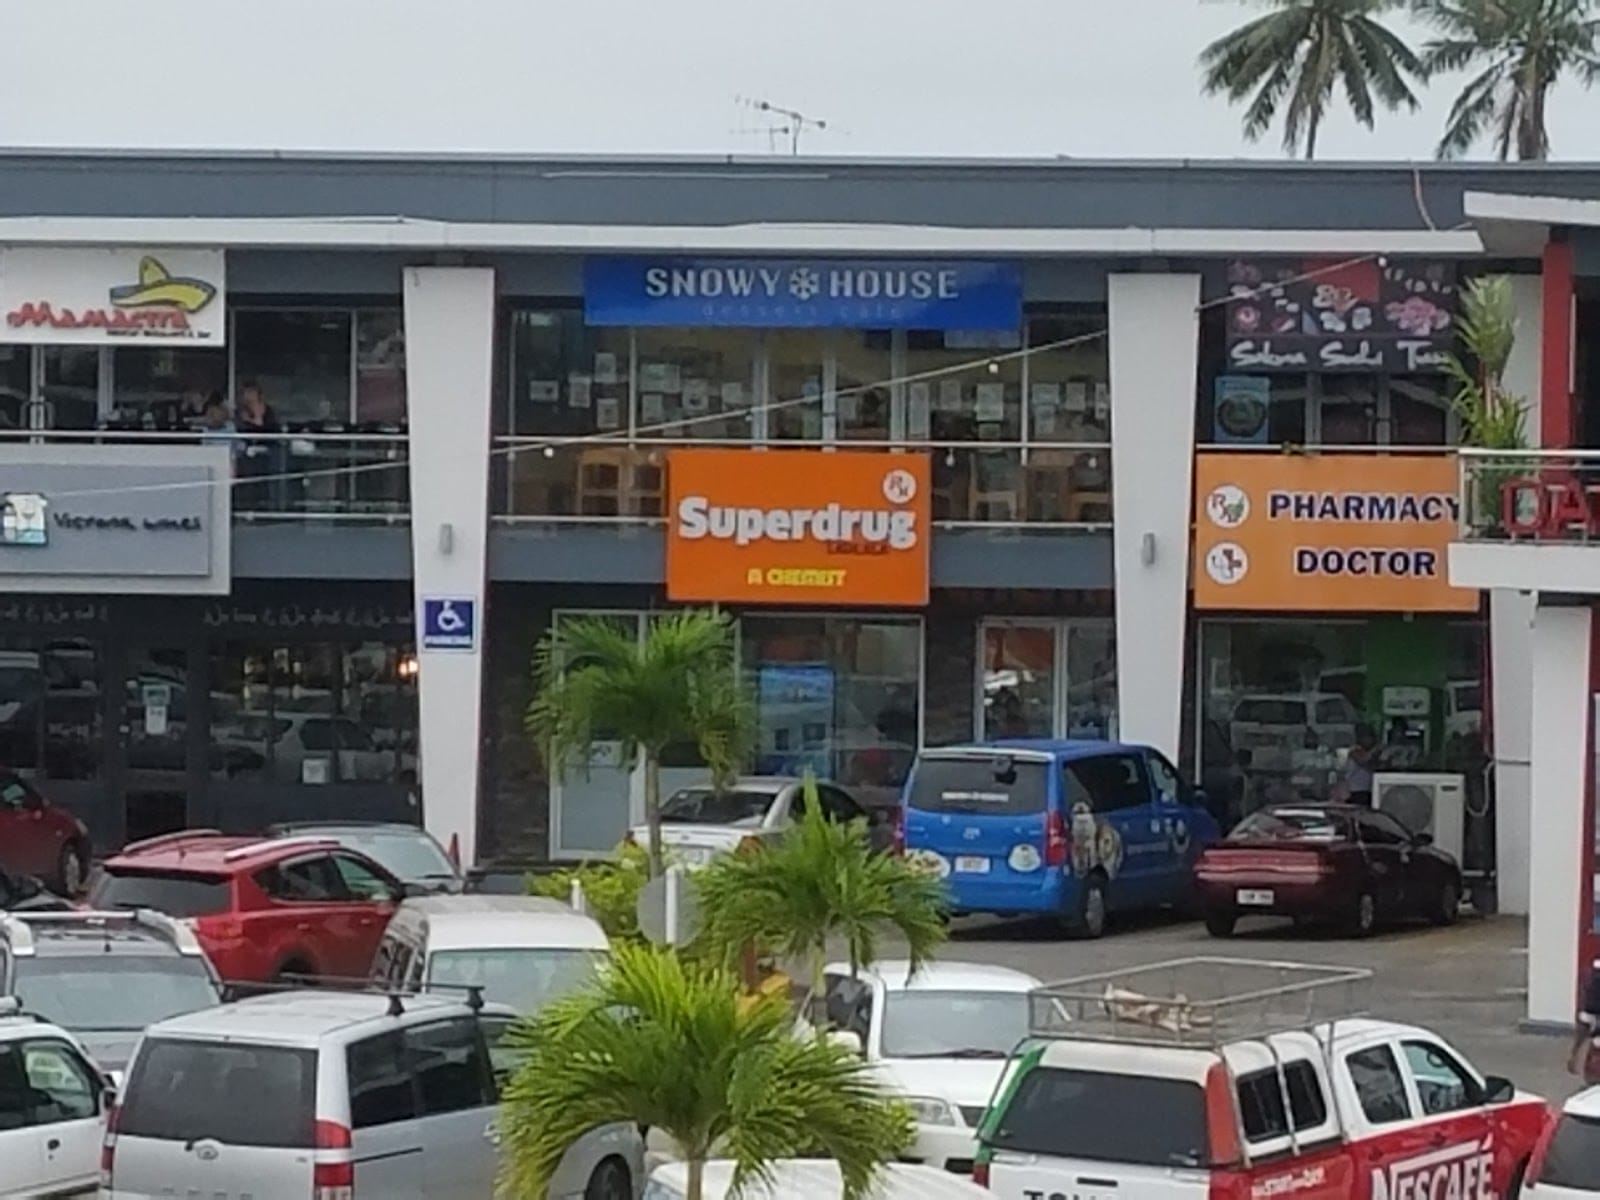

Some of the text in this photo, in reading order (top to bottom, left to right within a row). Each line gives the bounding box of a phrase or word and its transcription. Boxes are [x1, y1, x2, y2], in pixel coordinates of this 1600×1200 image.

[645, 268, 960, 299] SNOWY HOUSE
[678, 496, 917, 549] Superdrug
[1296, 550, 1437, 576] DOCTOR
